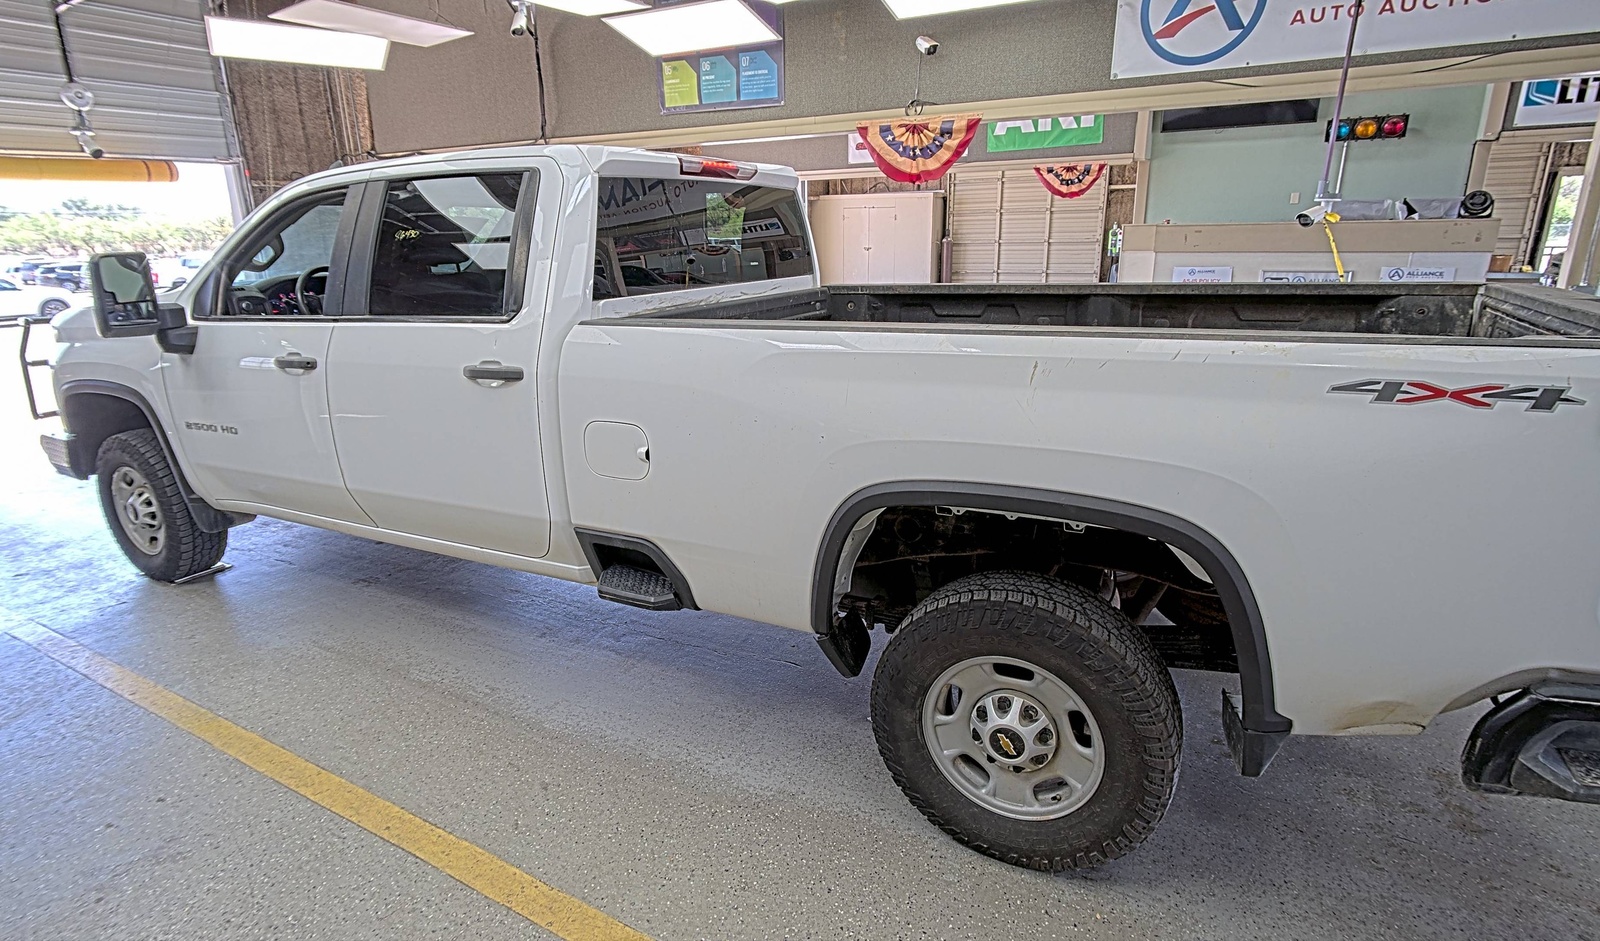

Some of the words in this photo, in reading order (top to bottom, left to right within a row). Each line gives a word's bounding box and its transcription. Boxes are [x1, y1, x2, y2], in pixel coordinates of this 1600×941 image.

[1290, 3, 1364, 26] AUTO
[702, 61, 710, 71] 06
[741, 56, 750, 67] 07
[1327, 378, 1587, 413] 4X4
[184, 421, 218, 433] 2500
[220, 425, 238, 435] HD
